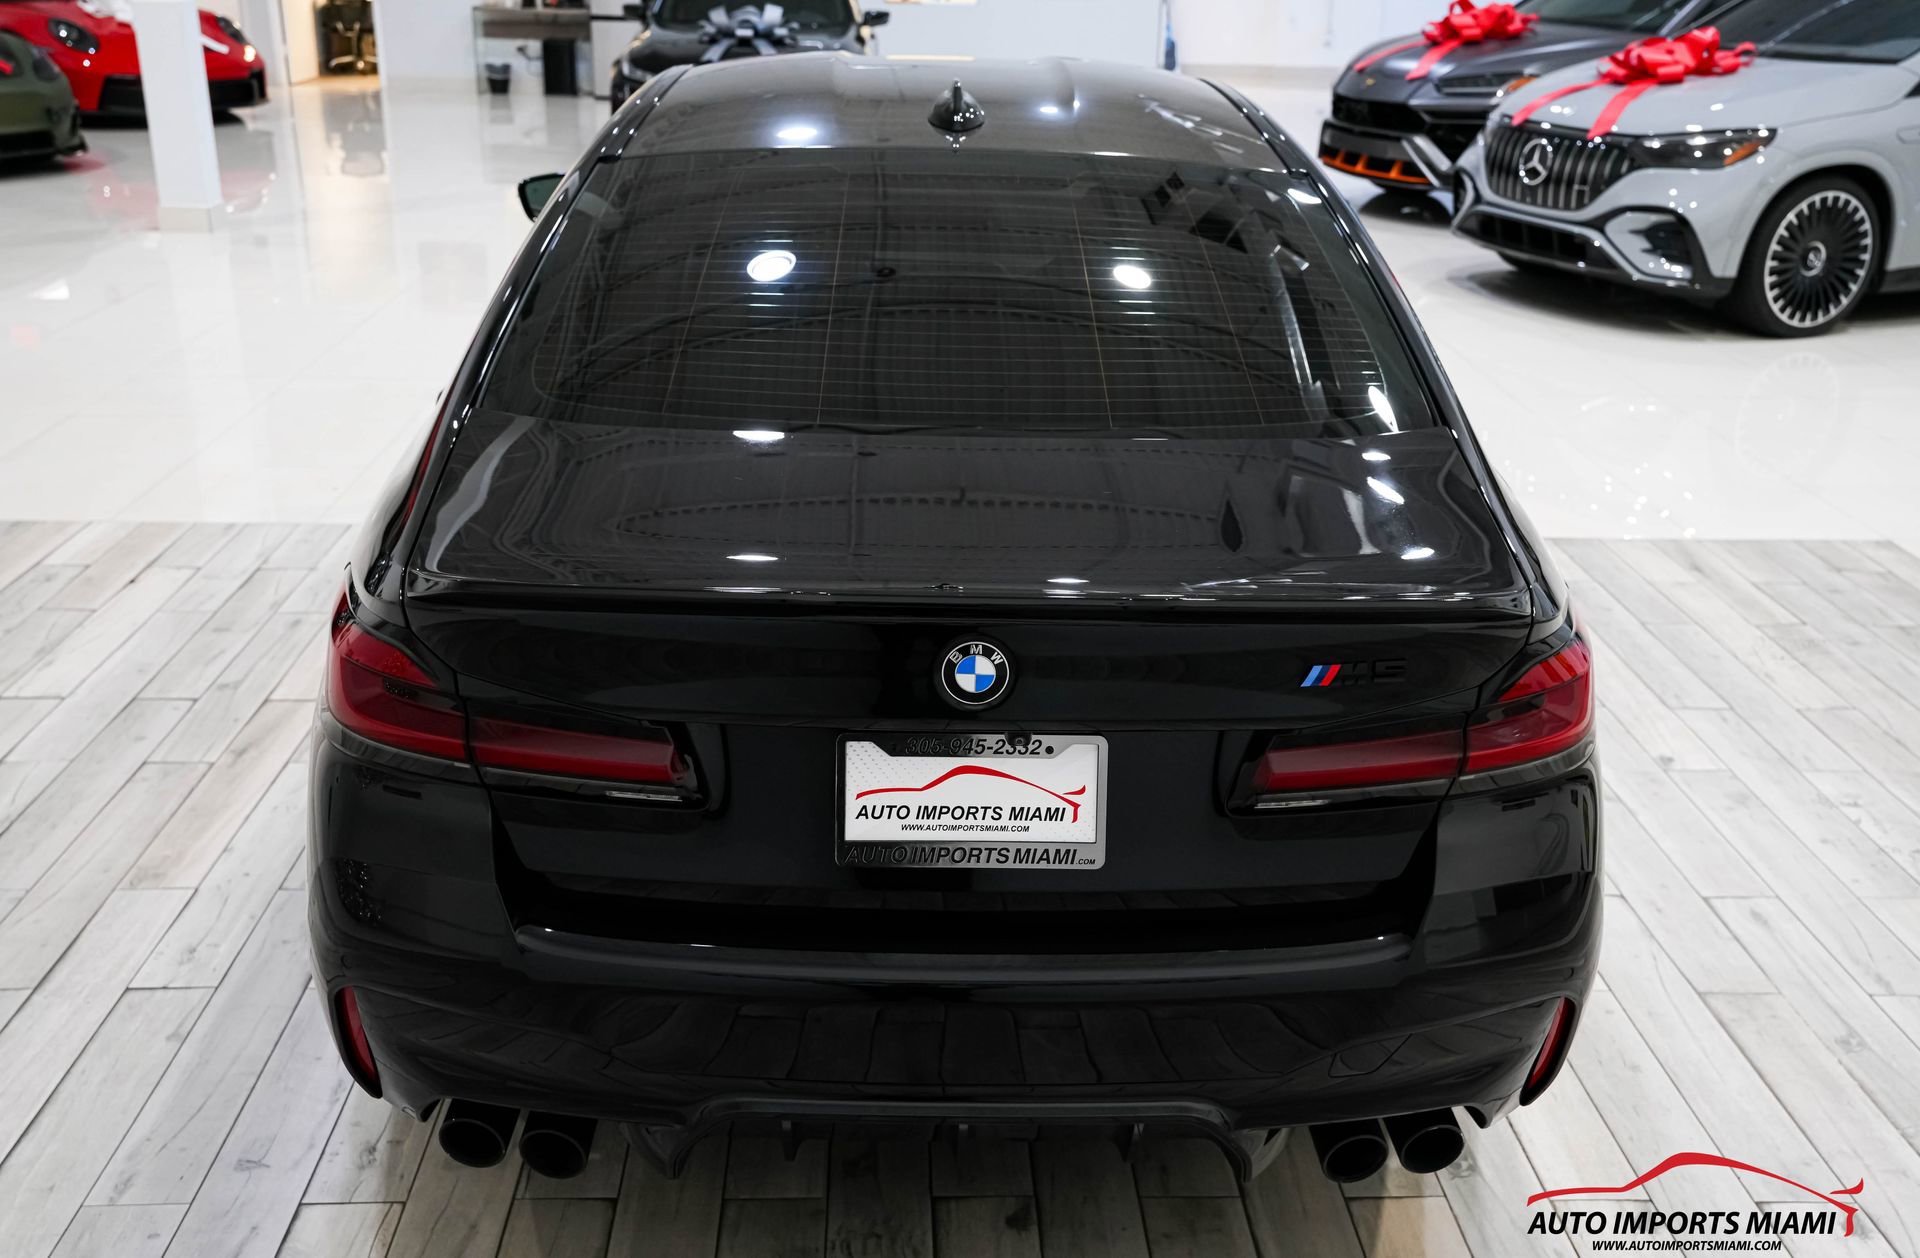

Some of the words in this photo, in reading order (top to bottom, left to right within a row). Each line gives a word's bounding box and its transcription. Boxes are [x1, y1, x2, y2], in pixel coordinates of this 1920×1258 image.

[949, 644, 1004, 665] BMW
[1341, 658, 1409, 686] M5
[905, 737, 1043, 756] 305-945-2332
[855, 804, 911, 821] AUTO
[915, 805, 1003, 822] IMPORTS
[1008, 806, 1066, 823] MIAMI
[901, 823, 1030, 833] WWW.AUTOIMPORTSMIAMI.COM
[844, 846, 908, 864] AUTO
[911, 846, 1010, 865] IMPORTS
